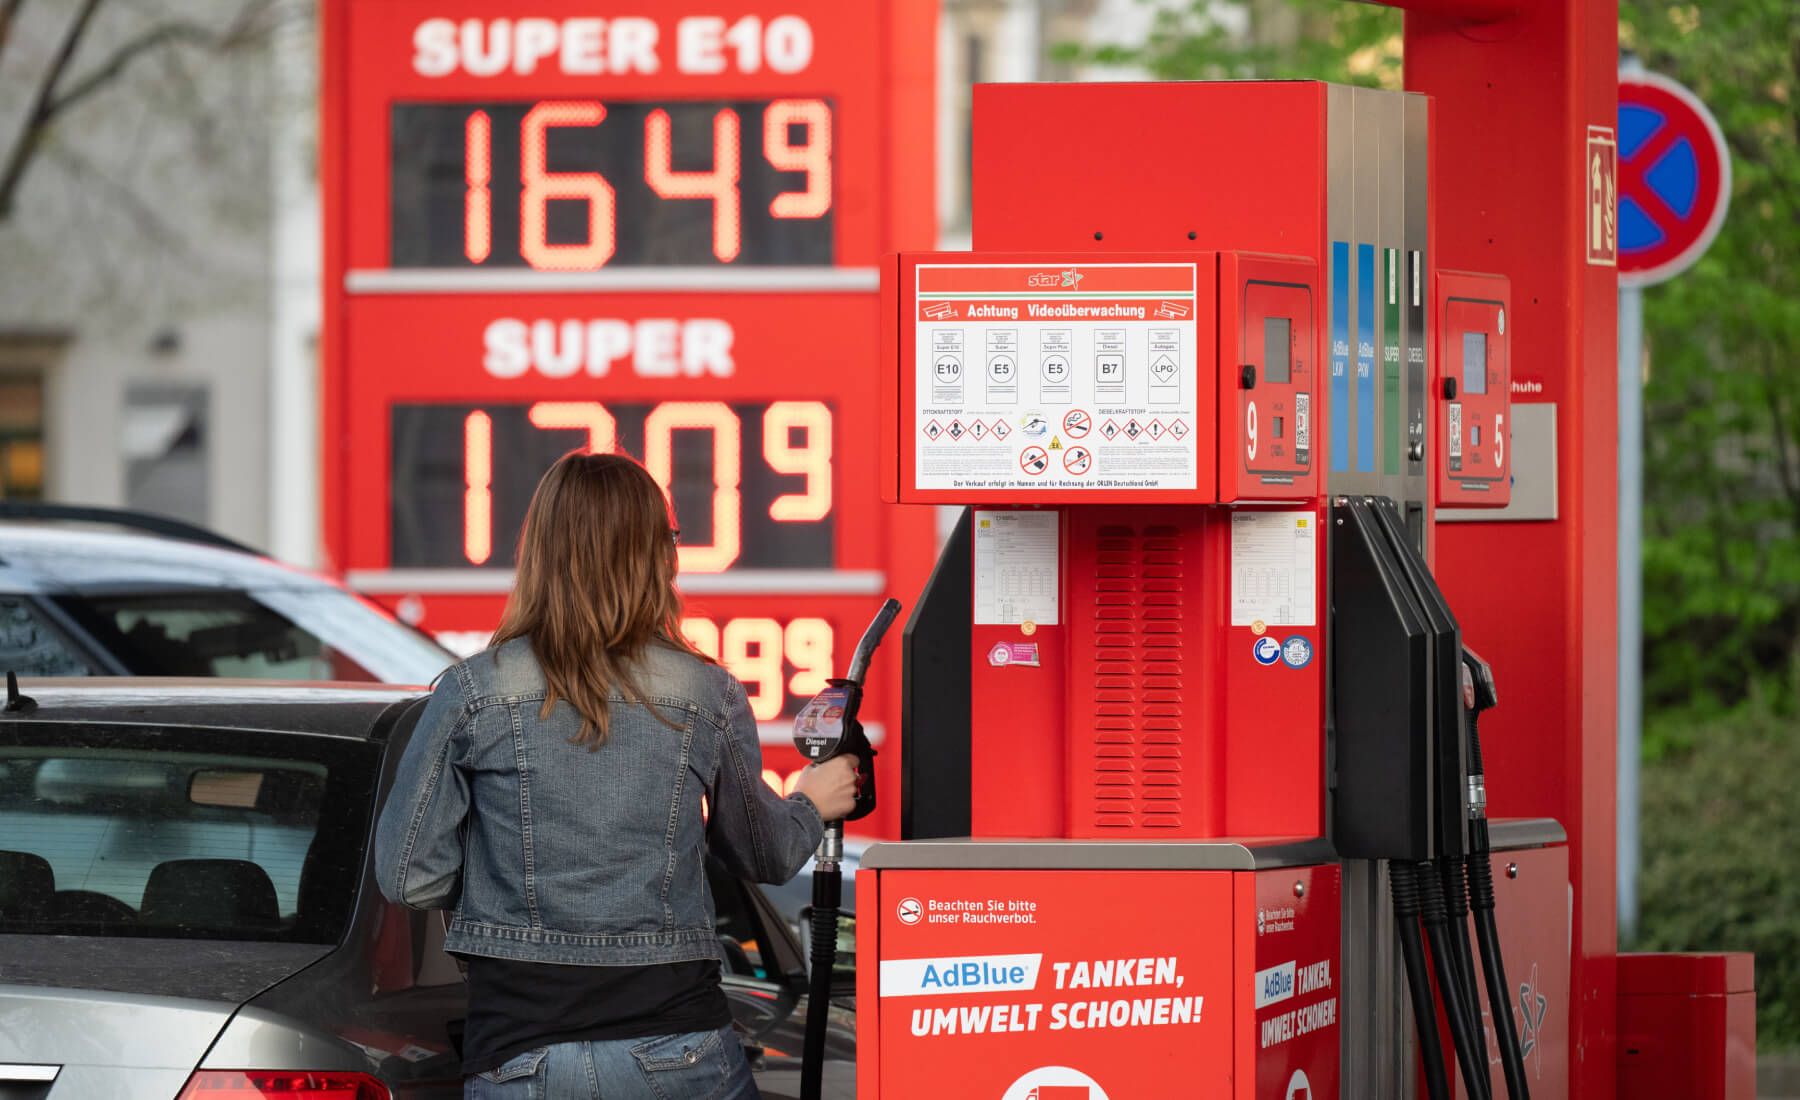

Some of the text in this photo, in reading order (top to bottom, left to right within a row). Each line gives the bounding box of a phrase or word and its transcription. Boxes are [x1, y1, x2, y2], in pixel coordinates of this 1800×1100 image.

[412, 15, 813, 77] SUPER E10
[1028, 273, 1060, 287] star
[967, 303, 1145, 319] Achtung Videoüberwachung
[482, 317, 737, 378] SUPER
[1384, 346, 1399, 362] SUPER
[1408, 347, 1424, 363] DIESEL
[937, 363, 959, 375] E10
[994, 363, 1009, 375] E5
[1048, 363, 1063, 375] E5
[1102, 363, 1118, 374] B7
[1155, 365, 1173, 373] LPG
[1247, 401, 1257, 461] 9
[1495, 414, 1503, 468] 5
[988, 480, 1007, 488] erfolgt
[1060, 480, 1084, 488] Rechnung
[929, 900, 1036, 912] Beachten Sie bitte
[929, 912, 1036, 924] unser Rauchverbot.
[1053, 957, 1184, 990] TANKEN,
[1298, 959, 1332, 996] TANKEN,
[911, 996, 1203, 1037] UMWELT SCHONEN!
[1261, 997, 1337, 1049] UMWELT SCHONEN!
